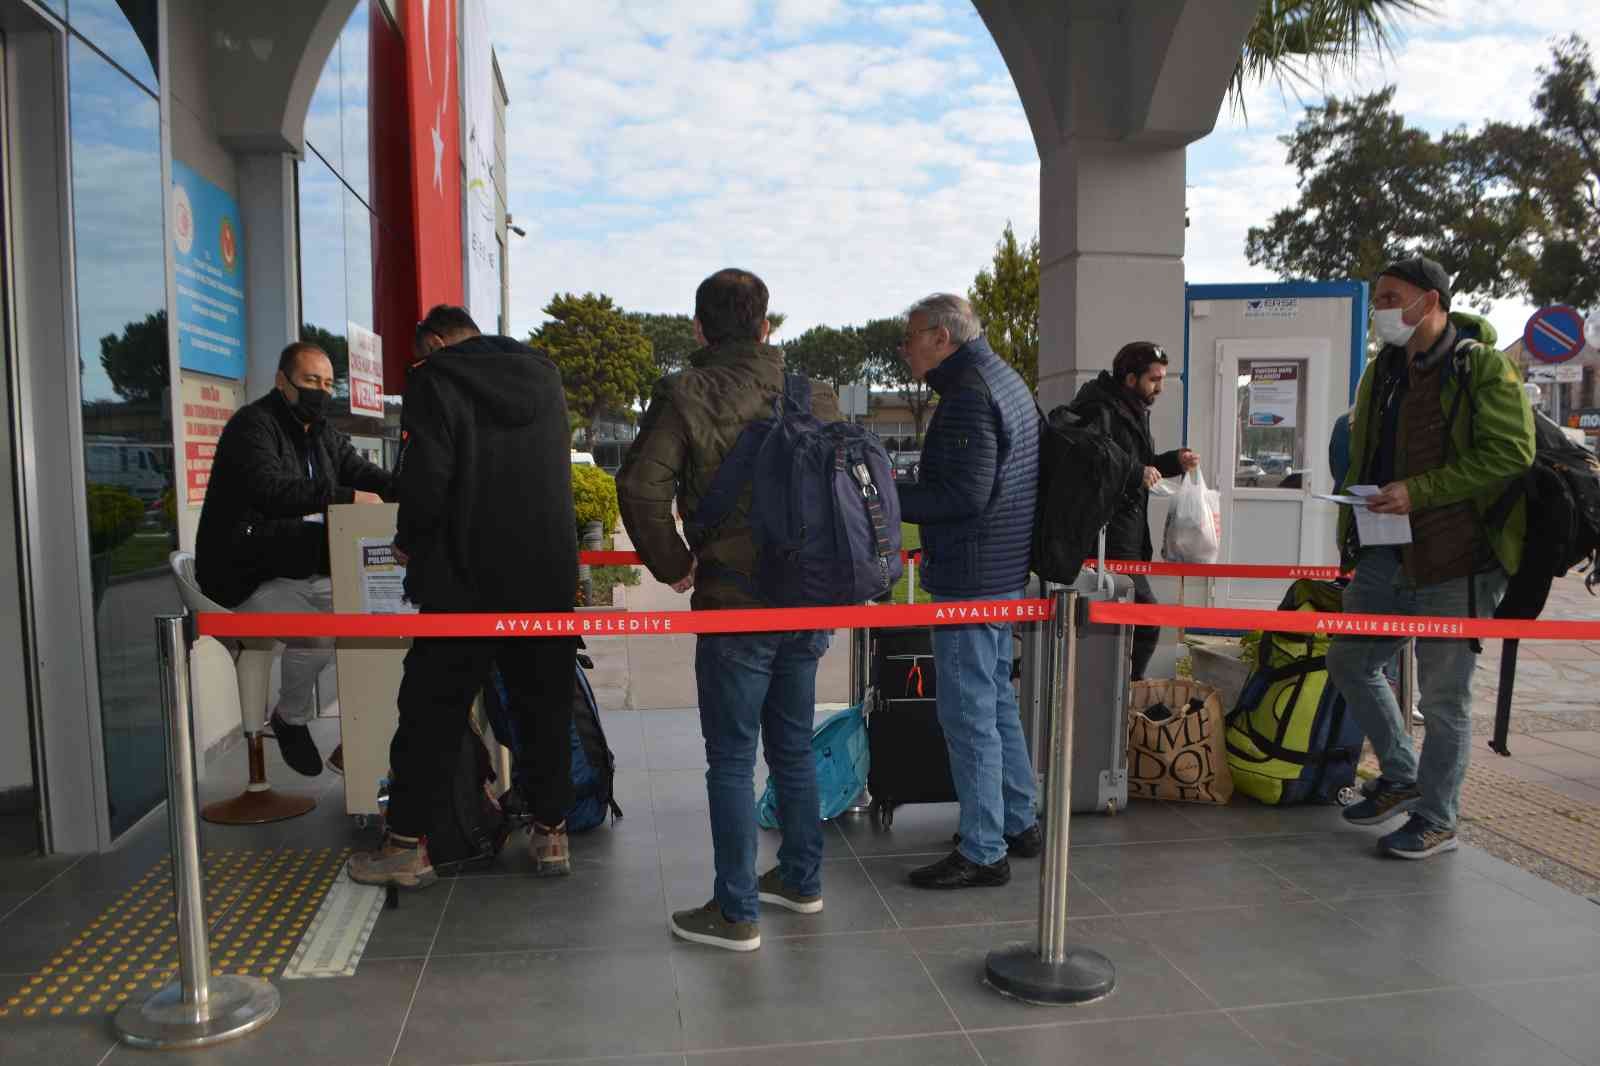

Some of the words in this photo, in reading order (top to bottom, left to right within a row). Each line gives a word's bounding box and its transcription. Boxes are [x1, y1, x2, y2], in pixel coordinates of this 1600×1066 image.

[935, 606, 1009, 618] AYVALIK
[495, 619, 575, 631] AYVALIK
[583, 616, 672, 631] BELEDİYE
[1316, 618, 1377, 631] AYVALIK
[1382, 618, 1464, 634] BELEDİYESİ
